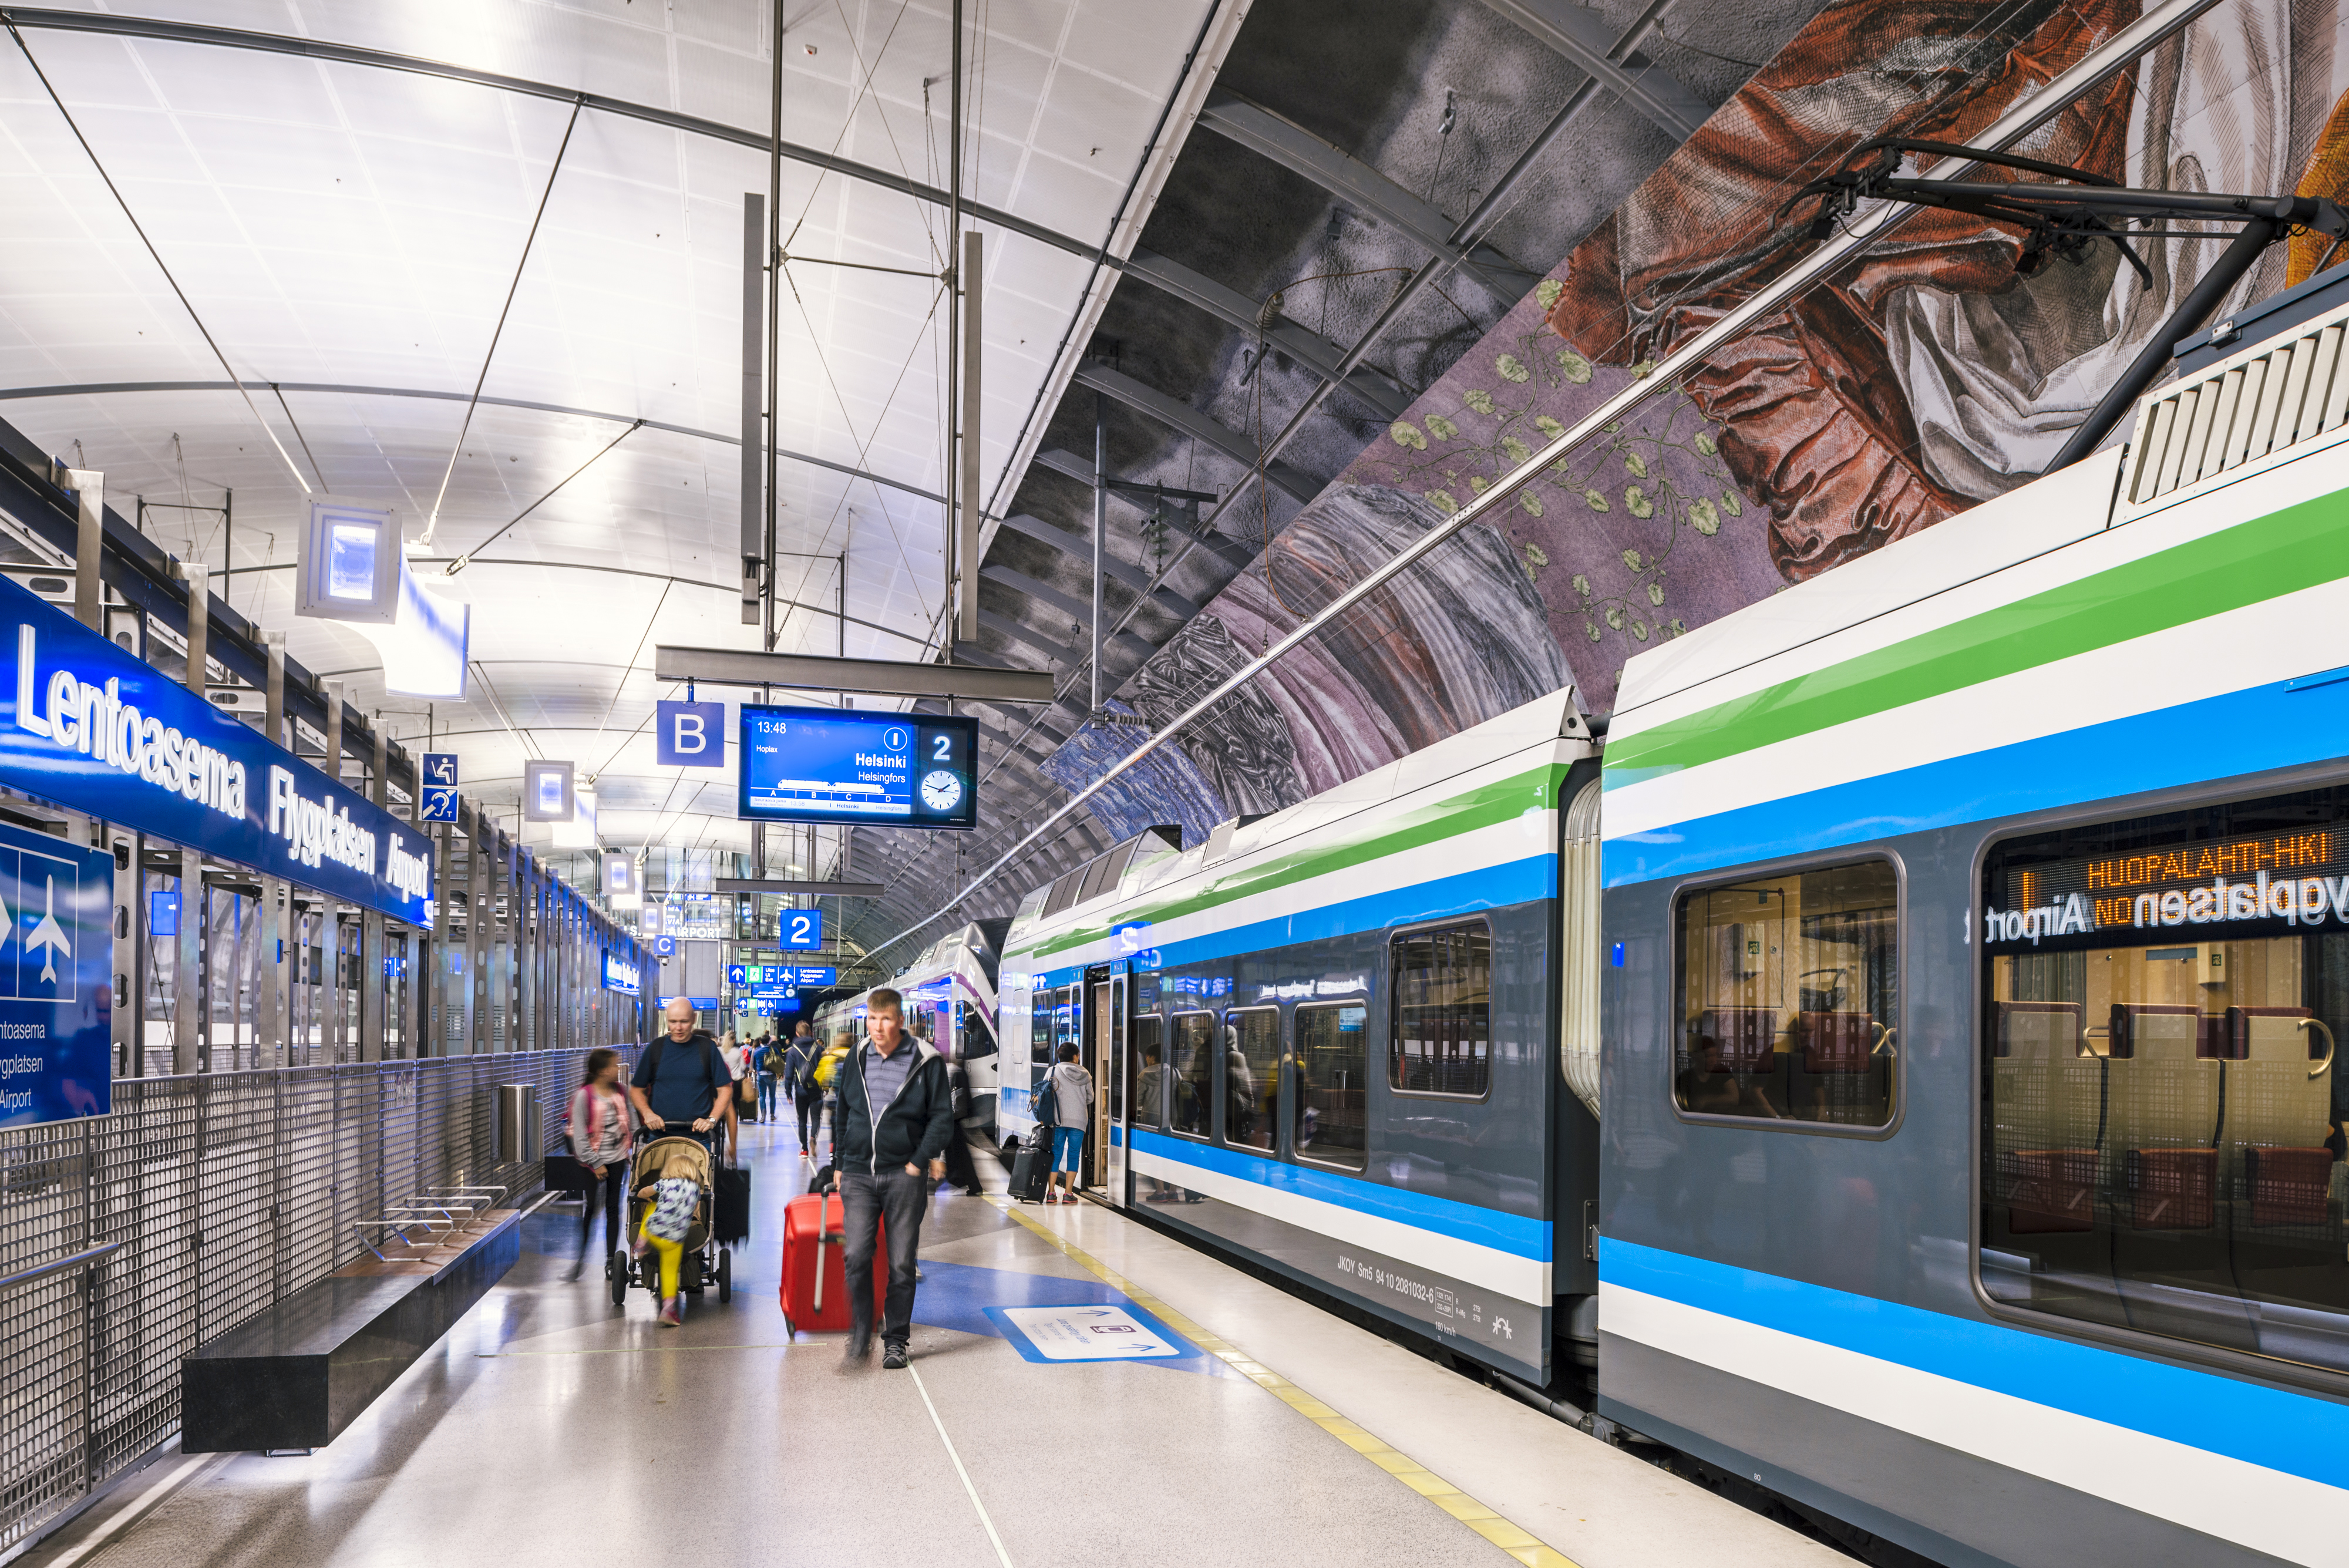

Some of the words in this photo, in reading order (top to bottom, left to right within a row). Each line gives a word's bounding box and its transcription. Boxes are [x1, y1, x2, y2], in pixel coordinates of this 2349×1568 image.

[674, 713, 706, 754] B
[758, 721, 786, 734] 13:48
[756, 745, 778, 753] Hoplax
[933, 735, 951, 761] 2
[16, 624, 245, 819] Lentoasema
[270, 765, 376, 875] Flygplatsen
[386, 833, 429, 903] Airport
[856, 753, 906, 768] Helsinki
[858, 771, 906, 784] Helsingfors
[2089, 833, 2327, 889] HUOPALAHTI-HKI
[2096, 897, 2131, 926] NO
[668, 927, 722, 938] AIRPORT
[791, 917, 810, 943] 2
[658, 938, 671, 952] C
[0, 1088, 32, 1113] Airport
[1338, 1255, 1355, 1274] JKOY
[1358, 1262, 1373, 1281] Sm5
[1376, 1268, 1384, 1286] 94
[1386, 1273, 1394, 1288] 10
[1395, 1276, 1434, 1304] 2081032-6
[1455, 1307, 1466, 1318] R+Mg
[1473, 1304, 1481, 1313] 275t
[1473, 1314, 1481, 1323] 275t
[1435, 1321, 1443, 1332] 160
[1443, 1324, 1456, 1337] km/h
[1754, 1473, 1761, 1482] 80
